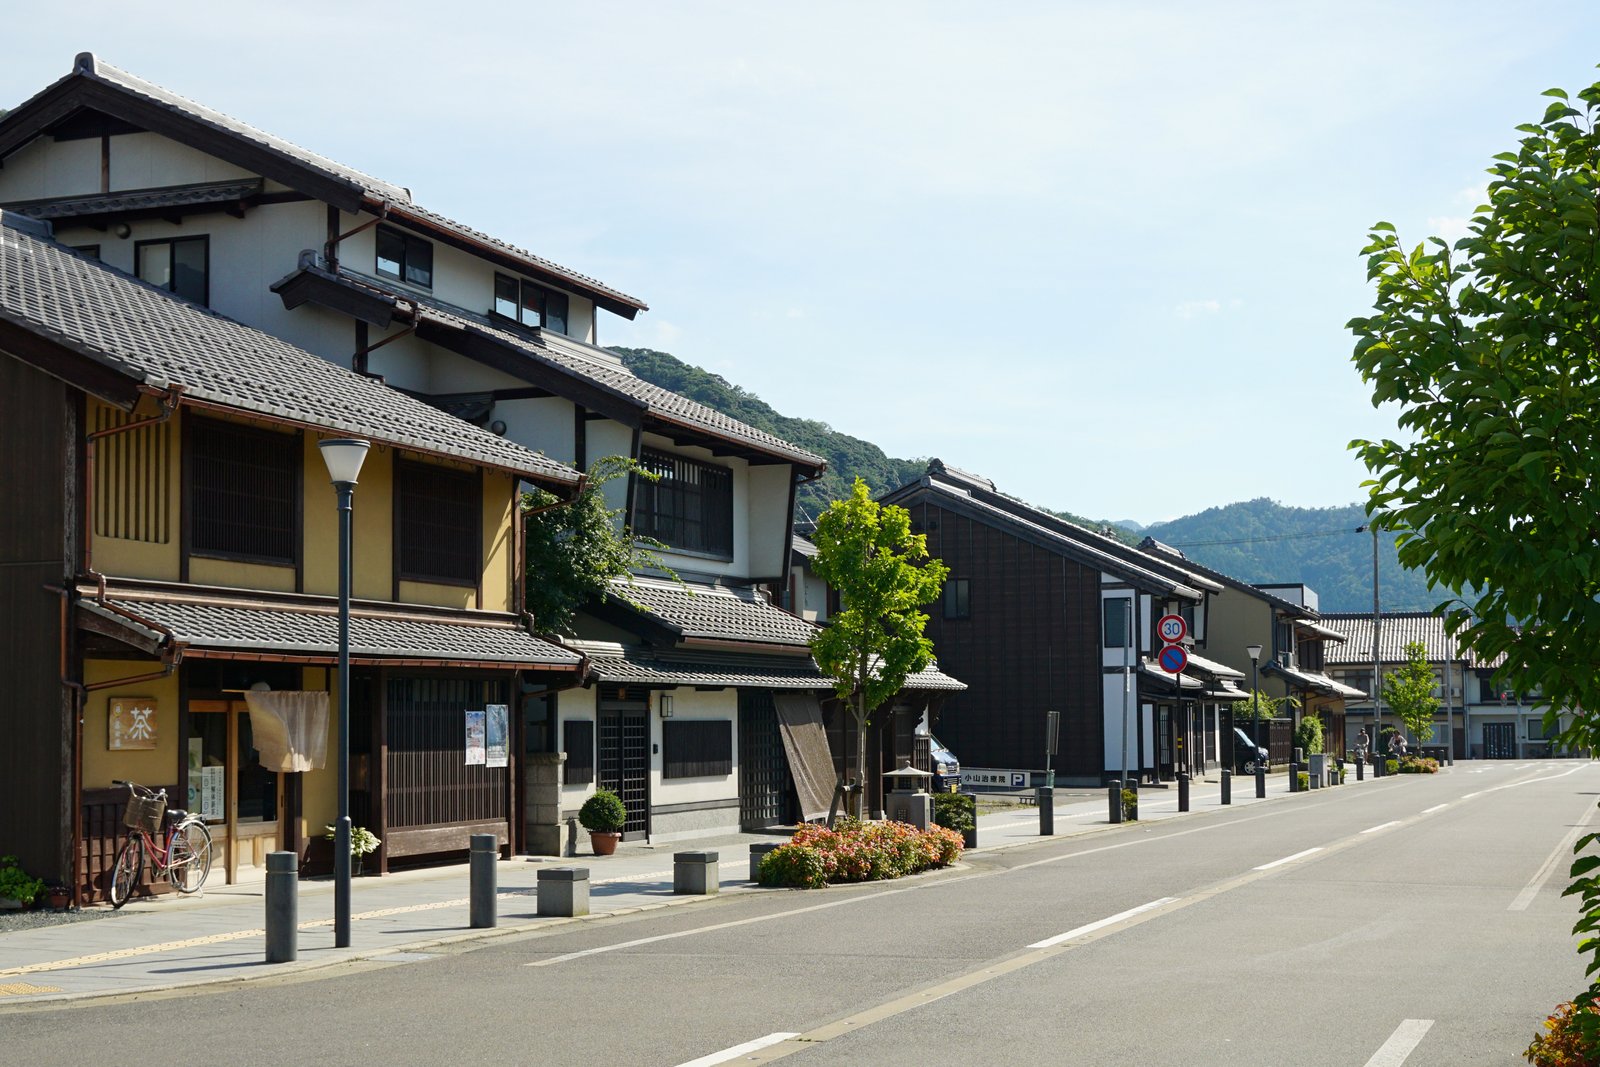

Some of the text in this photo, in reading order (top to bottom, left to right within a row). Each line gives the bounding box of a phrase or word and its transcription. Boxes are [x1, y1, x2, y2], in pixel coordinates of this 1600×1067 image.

[1164, 622, 1180, 635] 30
[130, 706, 153, 741] 茶
[964, 773, 1024, 786] 小山治療院 P
